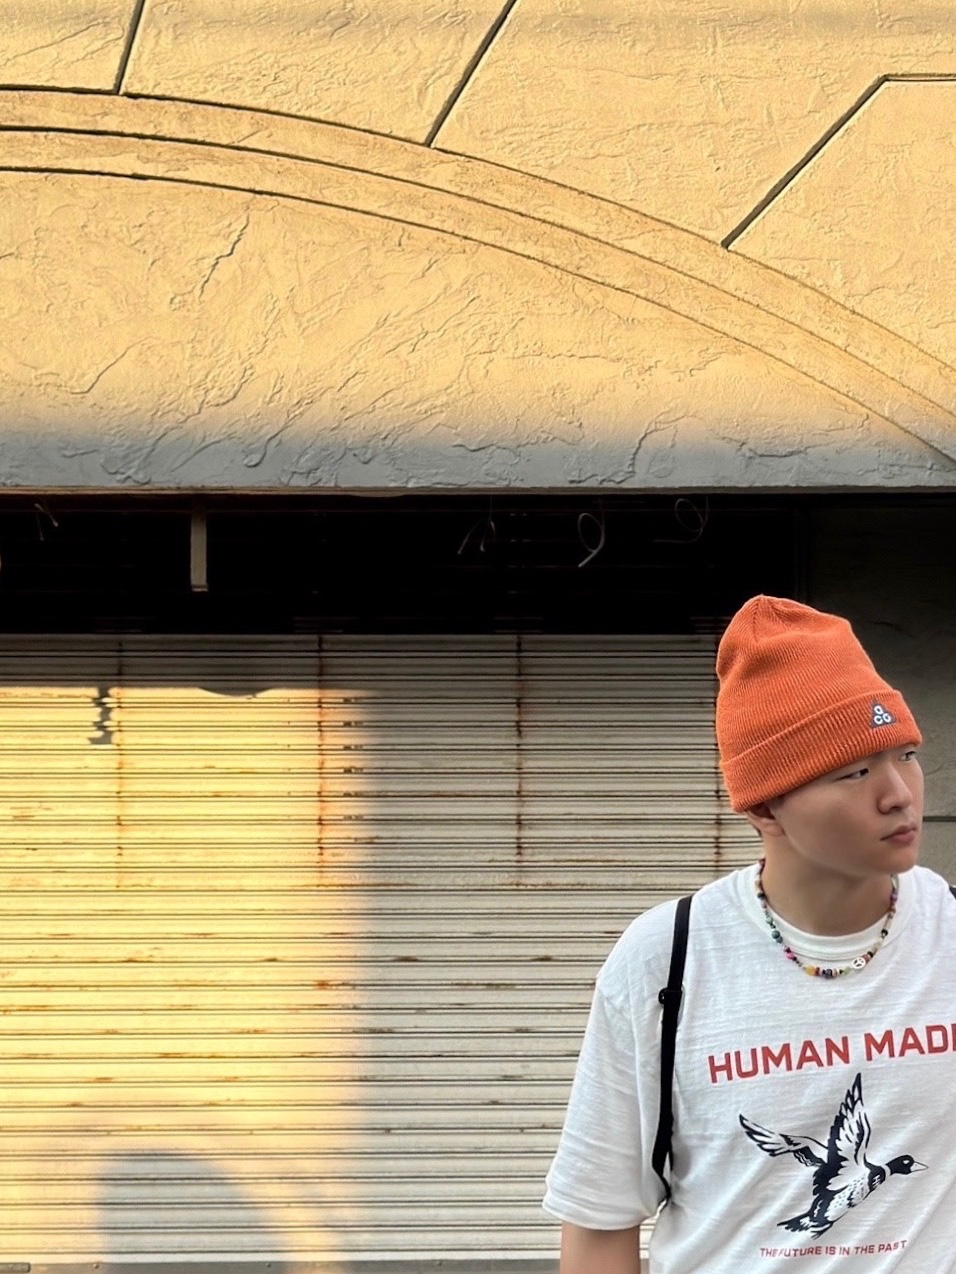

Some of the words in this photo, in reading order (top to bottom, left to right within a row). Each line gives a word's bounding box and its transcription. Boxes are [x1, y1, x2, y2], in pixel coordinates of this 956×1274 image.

[708, 1036, 850, 1083] HUMAN
[760, 1247, 778, 1257] THE
[777, 1245, 823, 1257] FUTURE
[825, 1245, 836, 1256] IS
[839, 1246, 850, 1256] IN
[854, 1243, 876, 1255] THE
[878, 1239, 909, 1253] PAST
